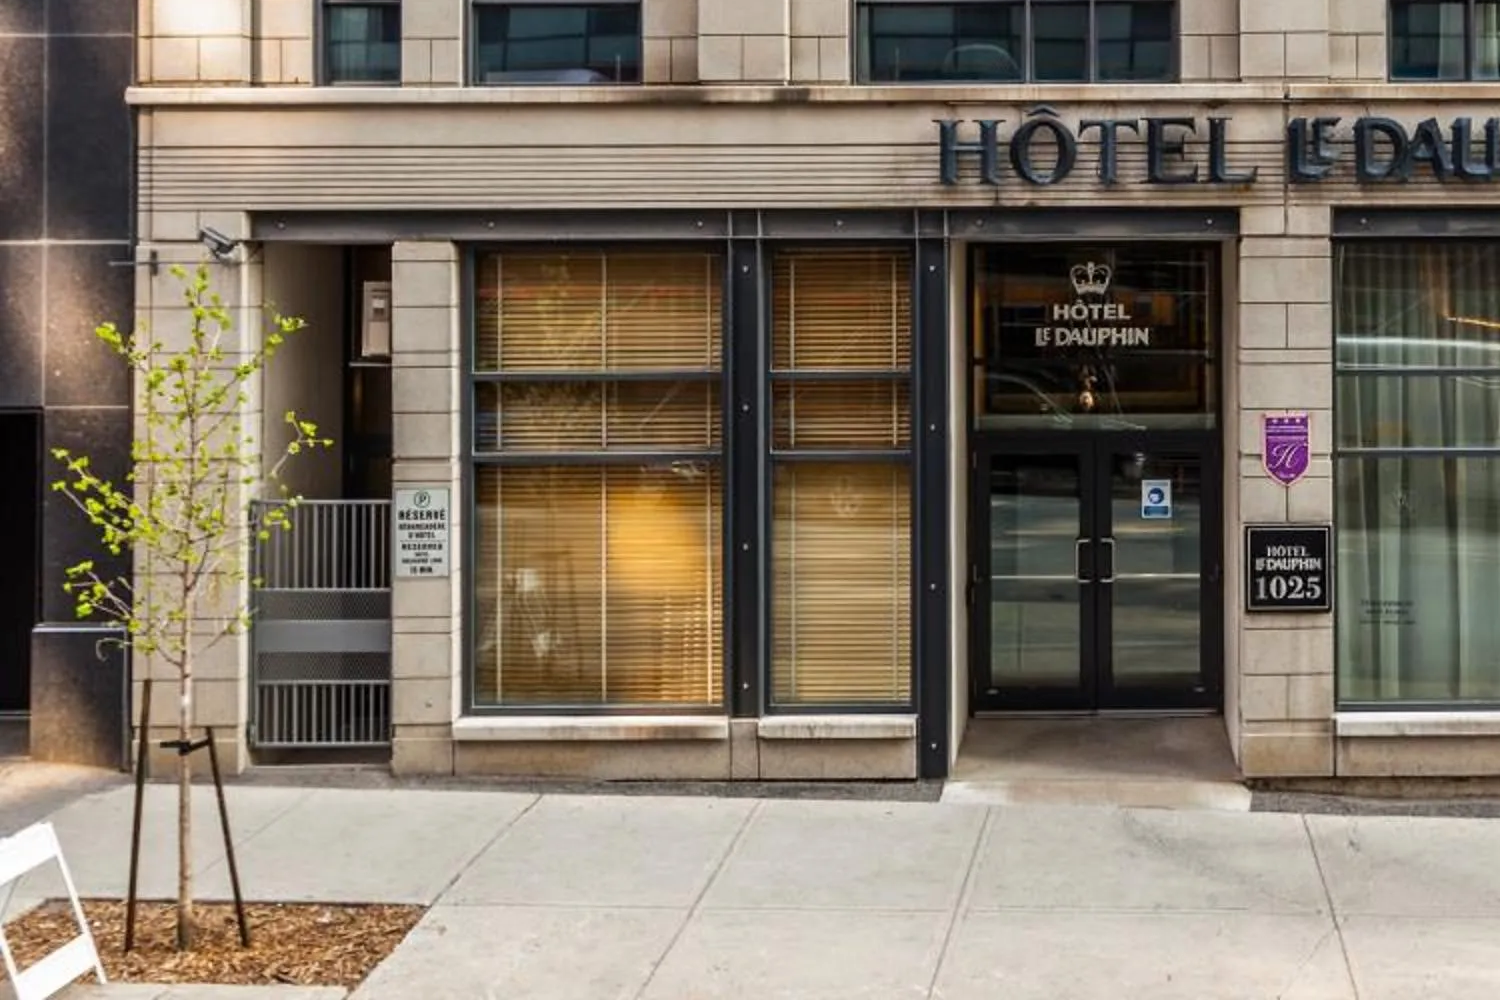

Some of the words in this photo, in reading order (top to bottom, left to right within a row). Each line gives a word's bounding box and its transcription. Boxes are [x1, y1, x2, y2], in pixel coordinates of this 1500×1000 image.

[932, 104, 1258, 187] HÔTEL
[1286, 116, 1342, 184] LE
[1053, 299, 1132, 320] HÔTEL
[1035, 327, 1052, 346] LE
[1055, 327, 1150, 346] DAUPHIN
[398, 508, 445, 520] RÉSERVÉ
[1266, 557, 1322, 571] DAUPHIN
[1255, 575, 1322, 599] 1025
